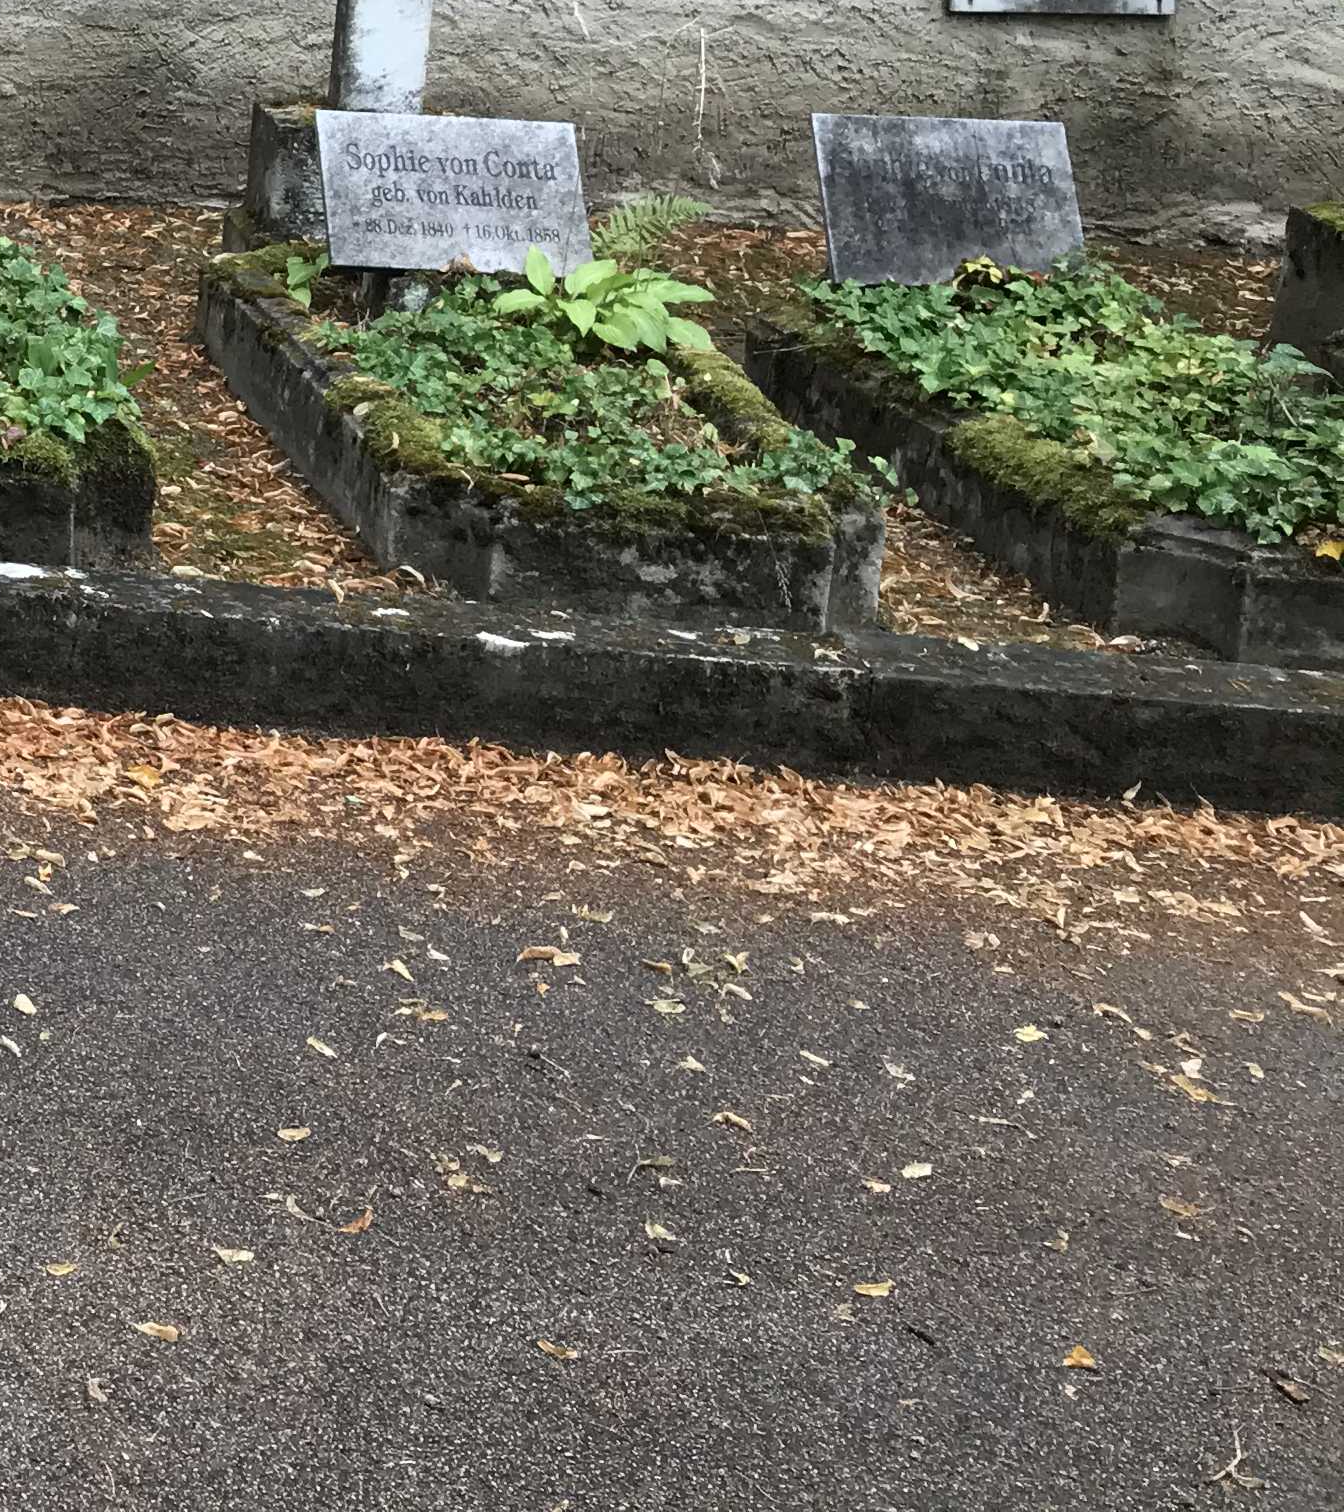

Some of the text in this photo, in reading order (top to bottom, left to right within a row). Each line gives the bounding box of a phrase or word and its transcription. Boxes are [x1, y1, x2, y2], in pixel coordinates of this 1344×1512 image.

[345, 142, 559, 181] Sophie von Conta
[371, 183, 540, 210] geb. von Kahlden
